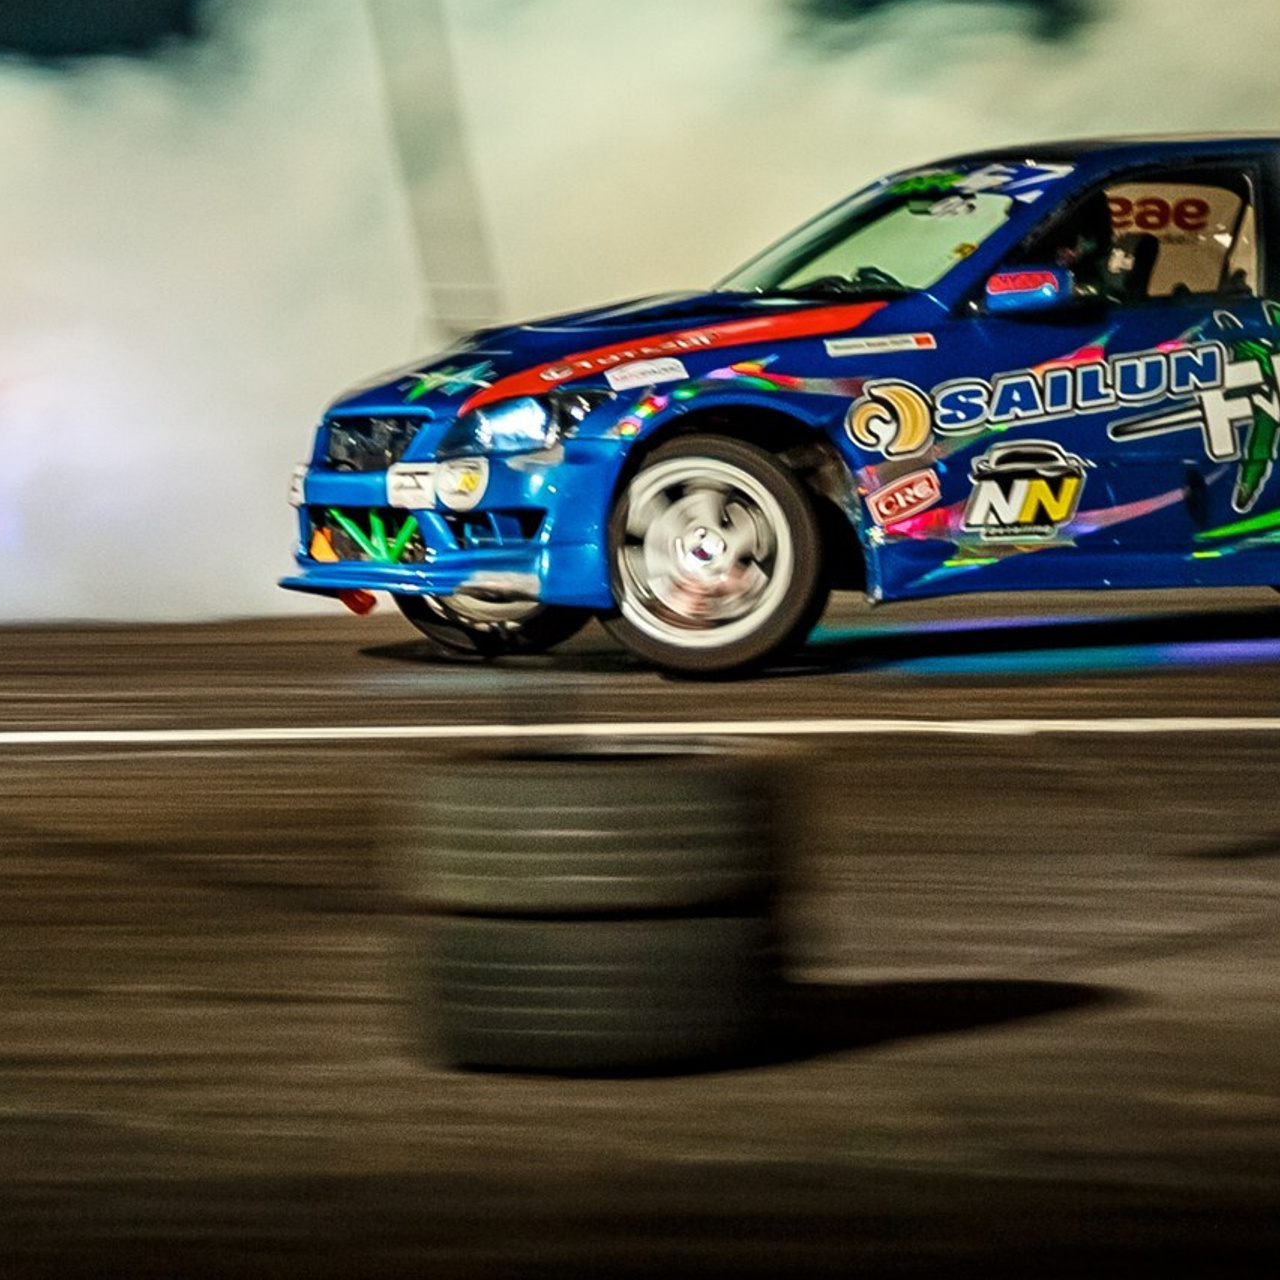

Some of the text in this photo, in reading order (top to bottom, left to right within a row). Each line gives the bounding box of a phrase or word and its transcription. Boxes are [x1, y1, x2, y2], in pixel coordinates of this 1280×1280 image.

[932, 344, 1223, 427] SAILUN
[877, 477, 935, 516] CRC
[968, 477, 1080, 524] NN
